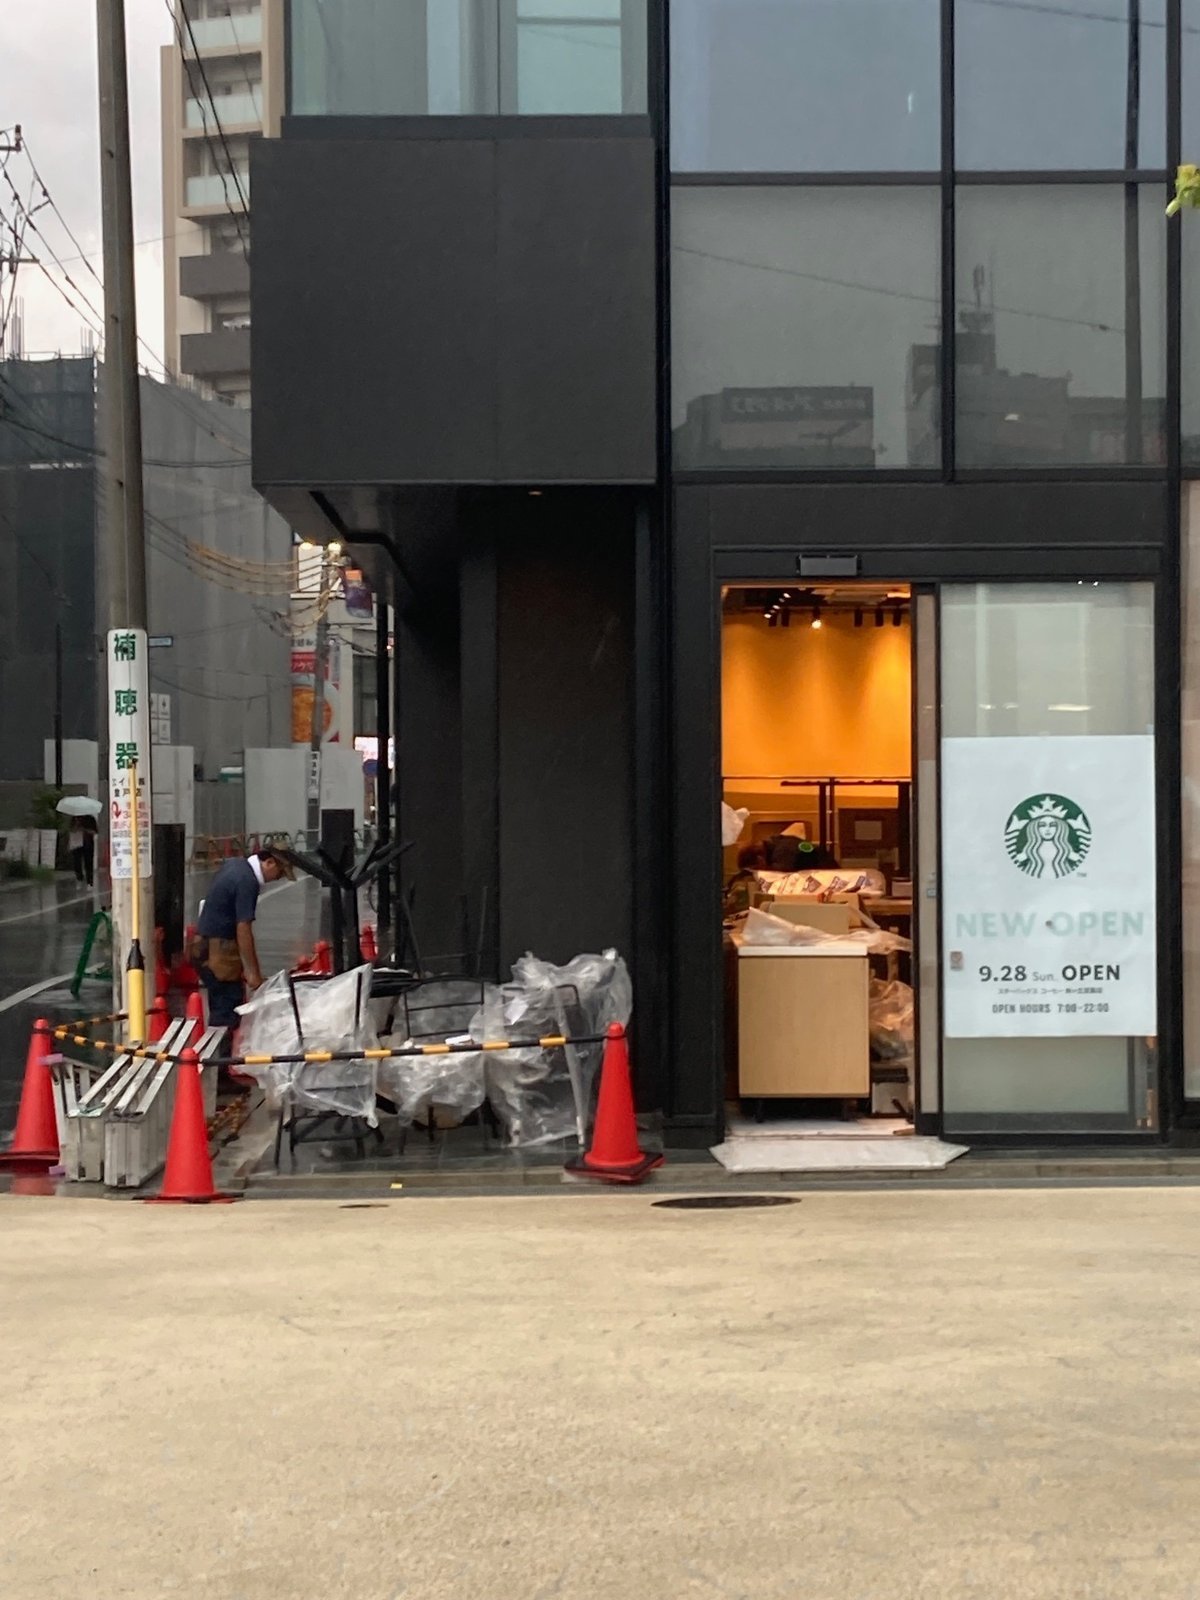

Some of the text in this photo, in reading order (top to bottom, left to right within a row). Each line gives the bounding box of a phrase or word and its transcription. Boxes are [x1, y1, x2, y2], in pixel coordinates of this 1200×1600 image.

[114, 633, 139, 770] 補聴器
[956, 911, 1144, 938] NEW OPEN
[979, 965, 1027, 982] 9.28
[1062, 964, 1121, 982] OPEN
[992, 1003, 1016, 1014] OPEN
[1019, 1003, 1051, 1014] HOURS
